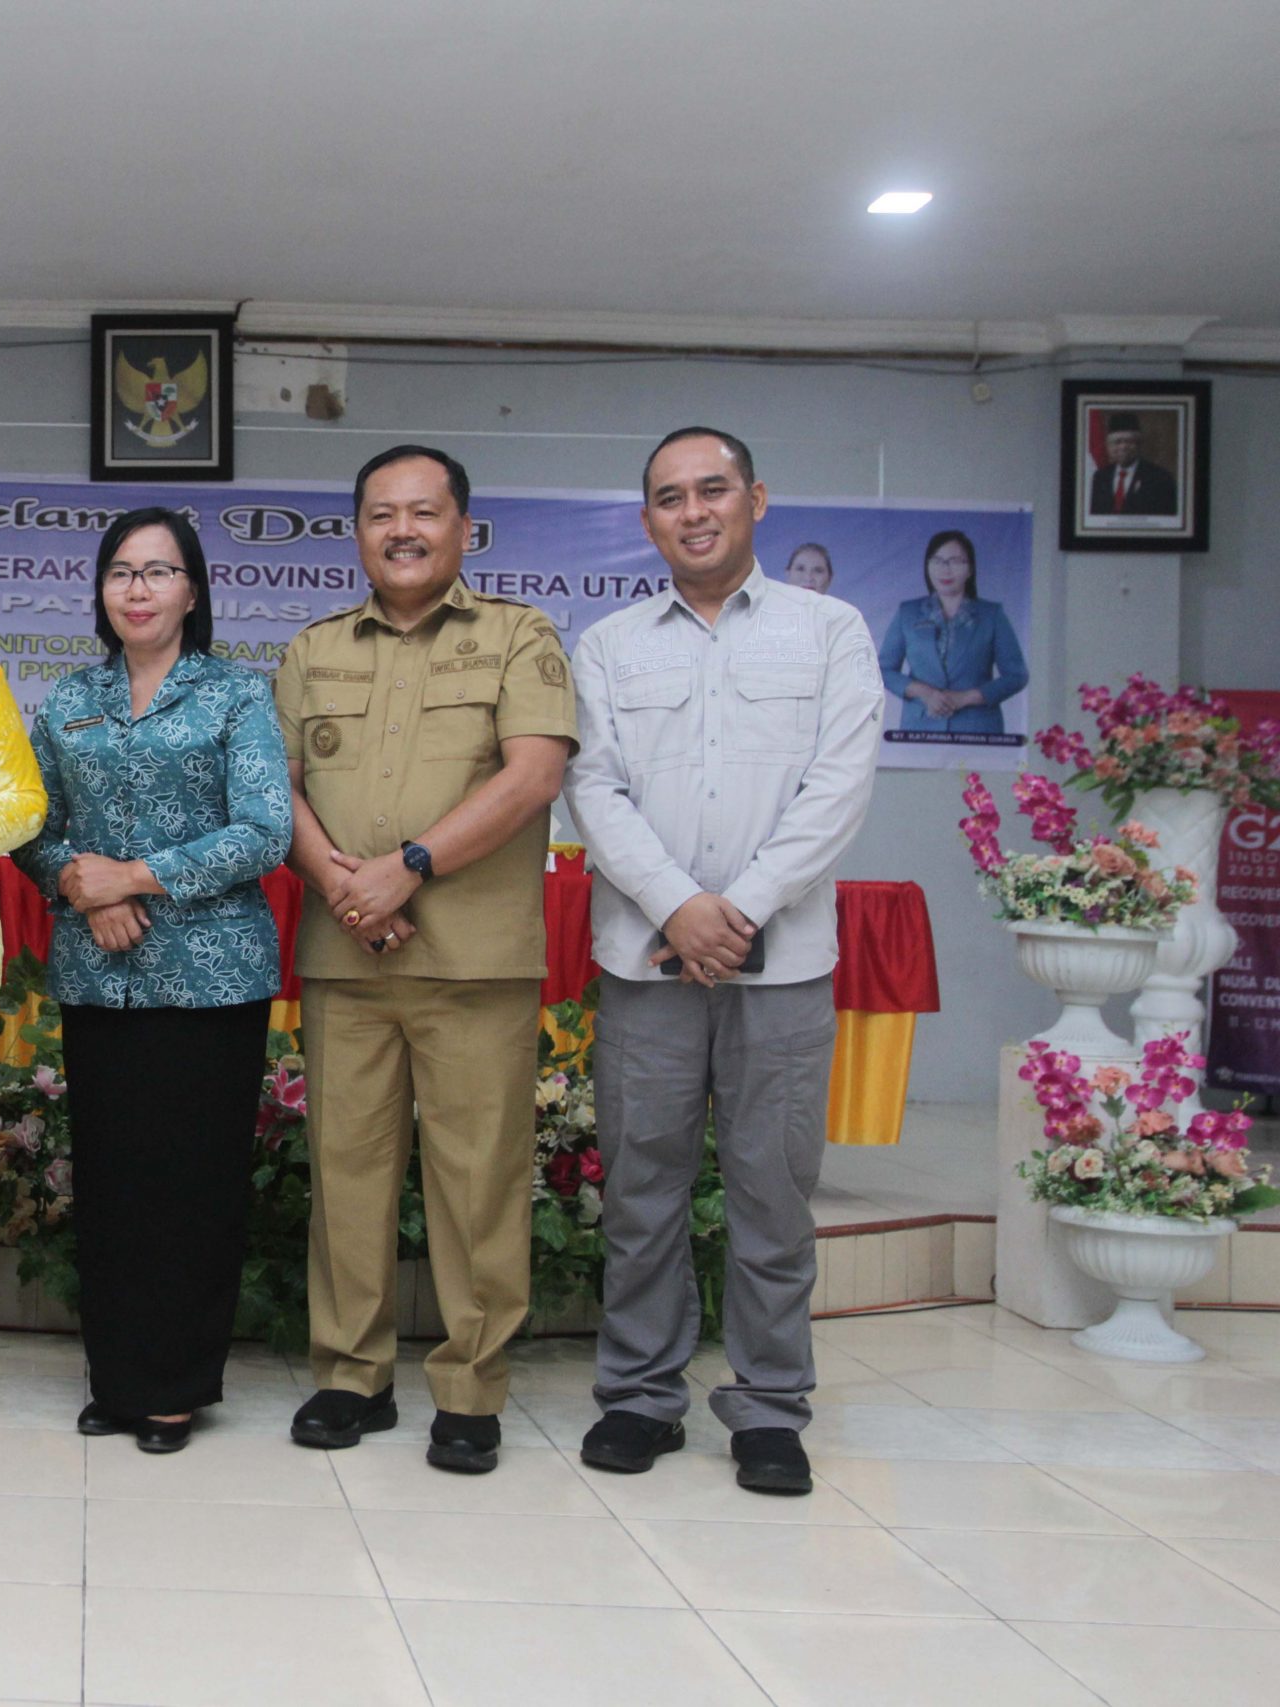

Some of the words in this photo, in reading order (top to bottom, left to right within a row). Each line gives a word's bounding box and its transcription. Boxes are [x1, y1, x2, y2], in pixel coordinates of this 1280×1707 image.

[221, 505, 493, 554] Dag
[210, 564, 355, 589] ROVINSI
[459, 572, 571, 597] TERA
[213, 600, 311, 622] IAS
[1228, 850, 1280, 864] INDO
[1219, 993, 1280, 1008] CONVENT
